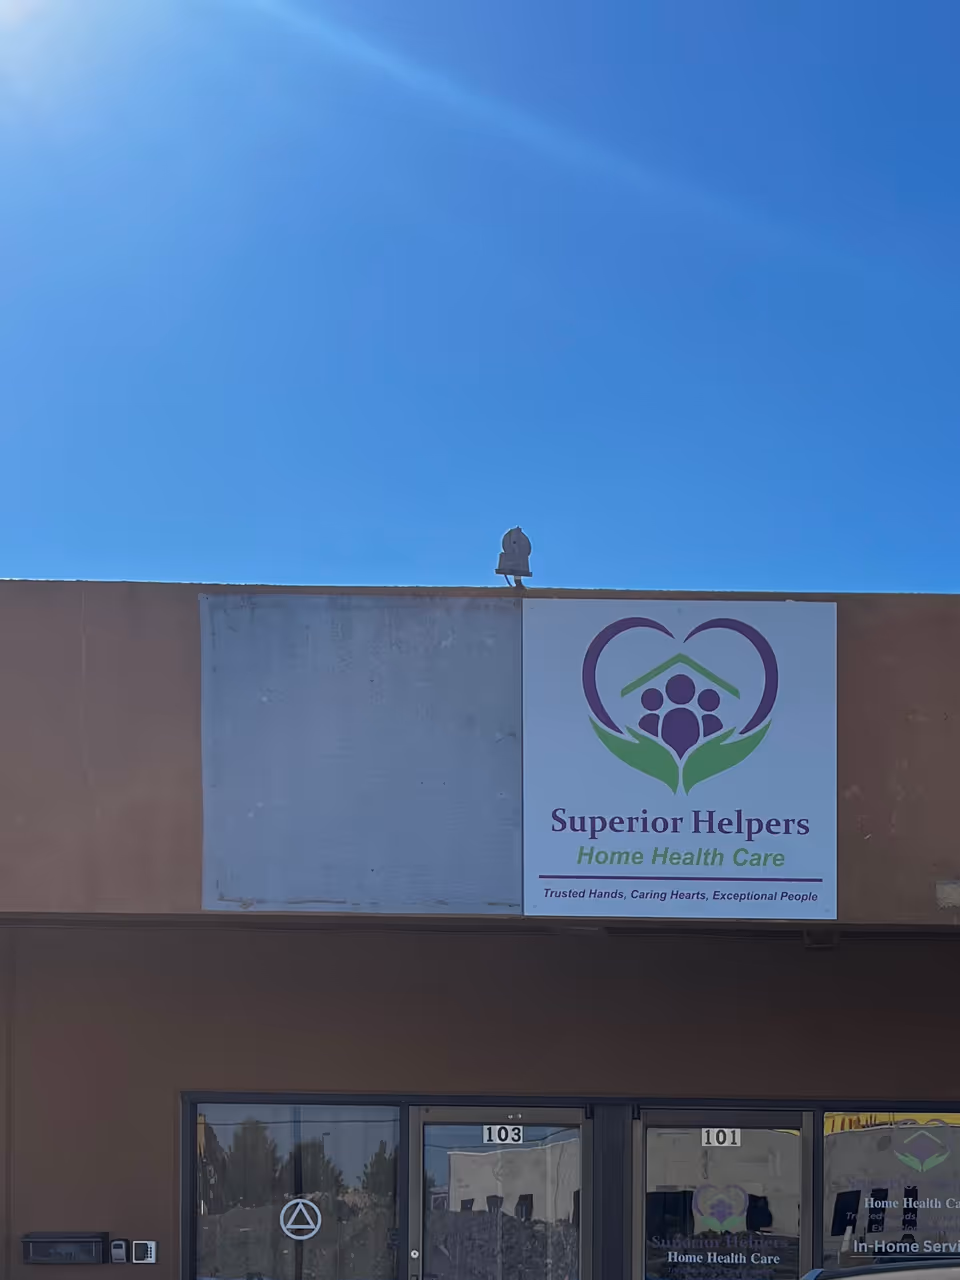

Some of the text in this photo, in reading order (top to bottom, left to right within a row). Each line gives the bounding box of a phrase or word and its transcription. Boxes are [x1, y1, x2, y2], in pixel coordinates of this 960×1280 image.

[551, 807, 810, 842] Superior Helpers
[576, 846, 785, 867] Home Health Care
[543, 888, 818, 903] Trusted Hands, Caring Hearts, Exceptional People
[486, 1126, 522, 1143] 103
[704, 1128, 738, 1145] 101
[864, 1197, 899, 1209] Home
[902, 1197, 942, 1209] Health
[853, 1240, 919, 1252] In-Home
[667, 1251, 780, 1264] Home Health Care
